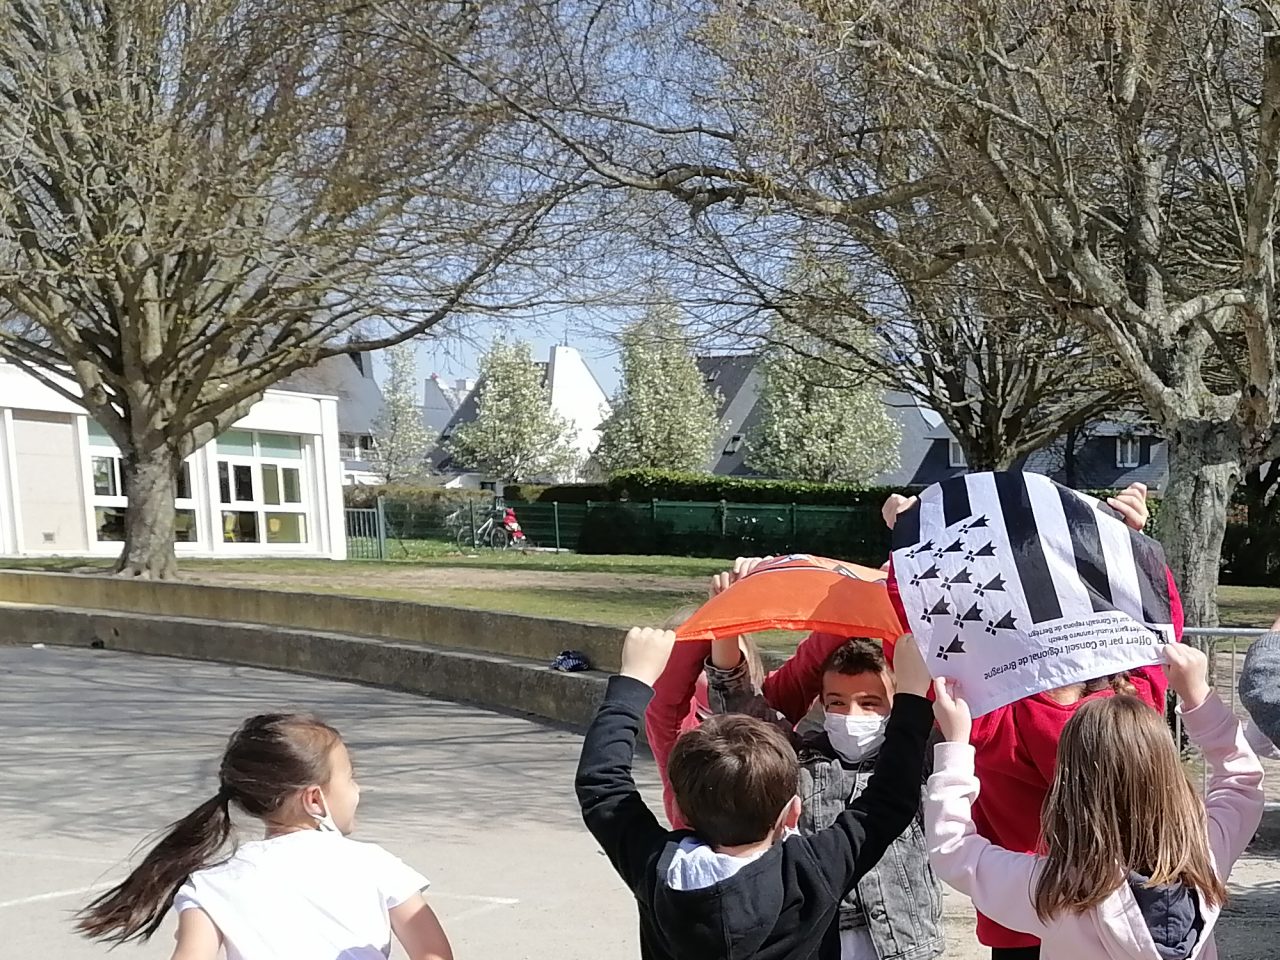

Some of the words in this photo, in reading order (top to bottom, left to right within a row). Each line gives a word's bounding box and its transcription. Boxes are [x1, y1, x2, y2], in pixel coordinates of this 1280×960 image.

[1099, 639, 1108, 648] le
[1109, 636, 1123, 645] par
[1126, 635, 1152, 645] Offert
[1065, 641, 1097, 655] Conseil
[1029, 646, 1063, 663] régional
[1018, 656, 1028, 666] de
[984, 661, 1017, 679] Bretagne
